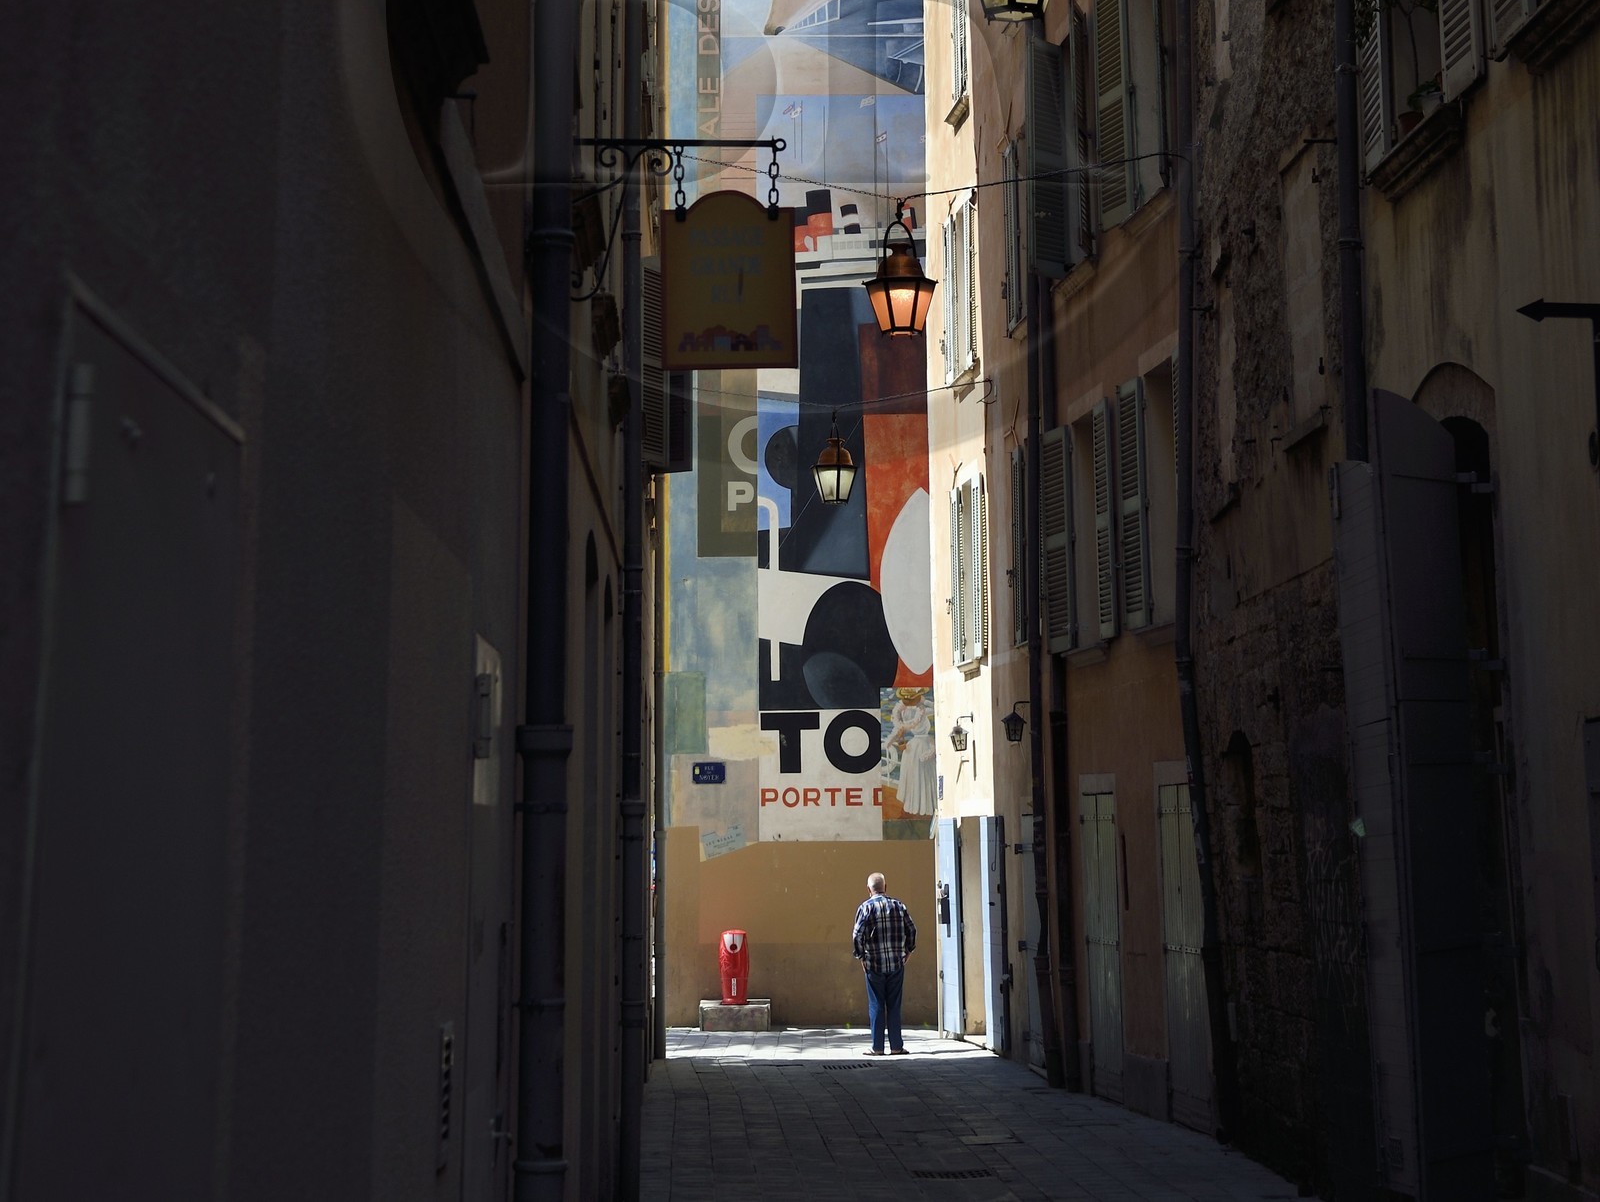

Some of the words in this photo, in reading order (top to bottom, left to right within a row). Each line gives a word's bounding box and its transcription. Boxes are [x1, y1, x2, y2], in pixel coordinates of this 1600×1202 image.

[727, 481, 755, 511] P
[760, 709, 882, 774] TO
[760, 787, 863, 808] PORTE
